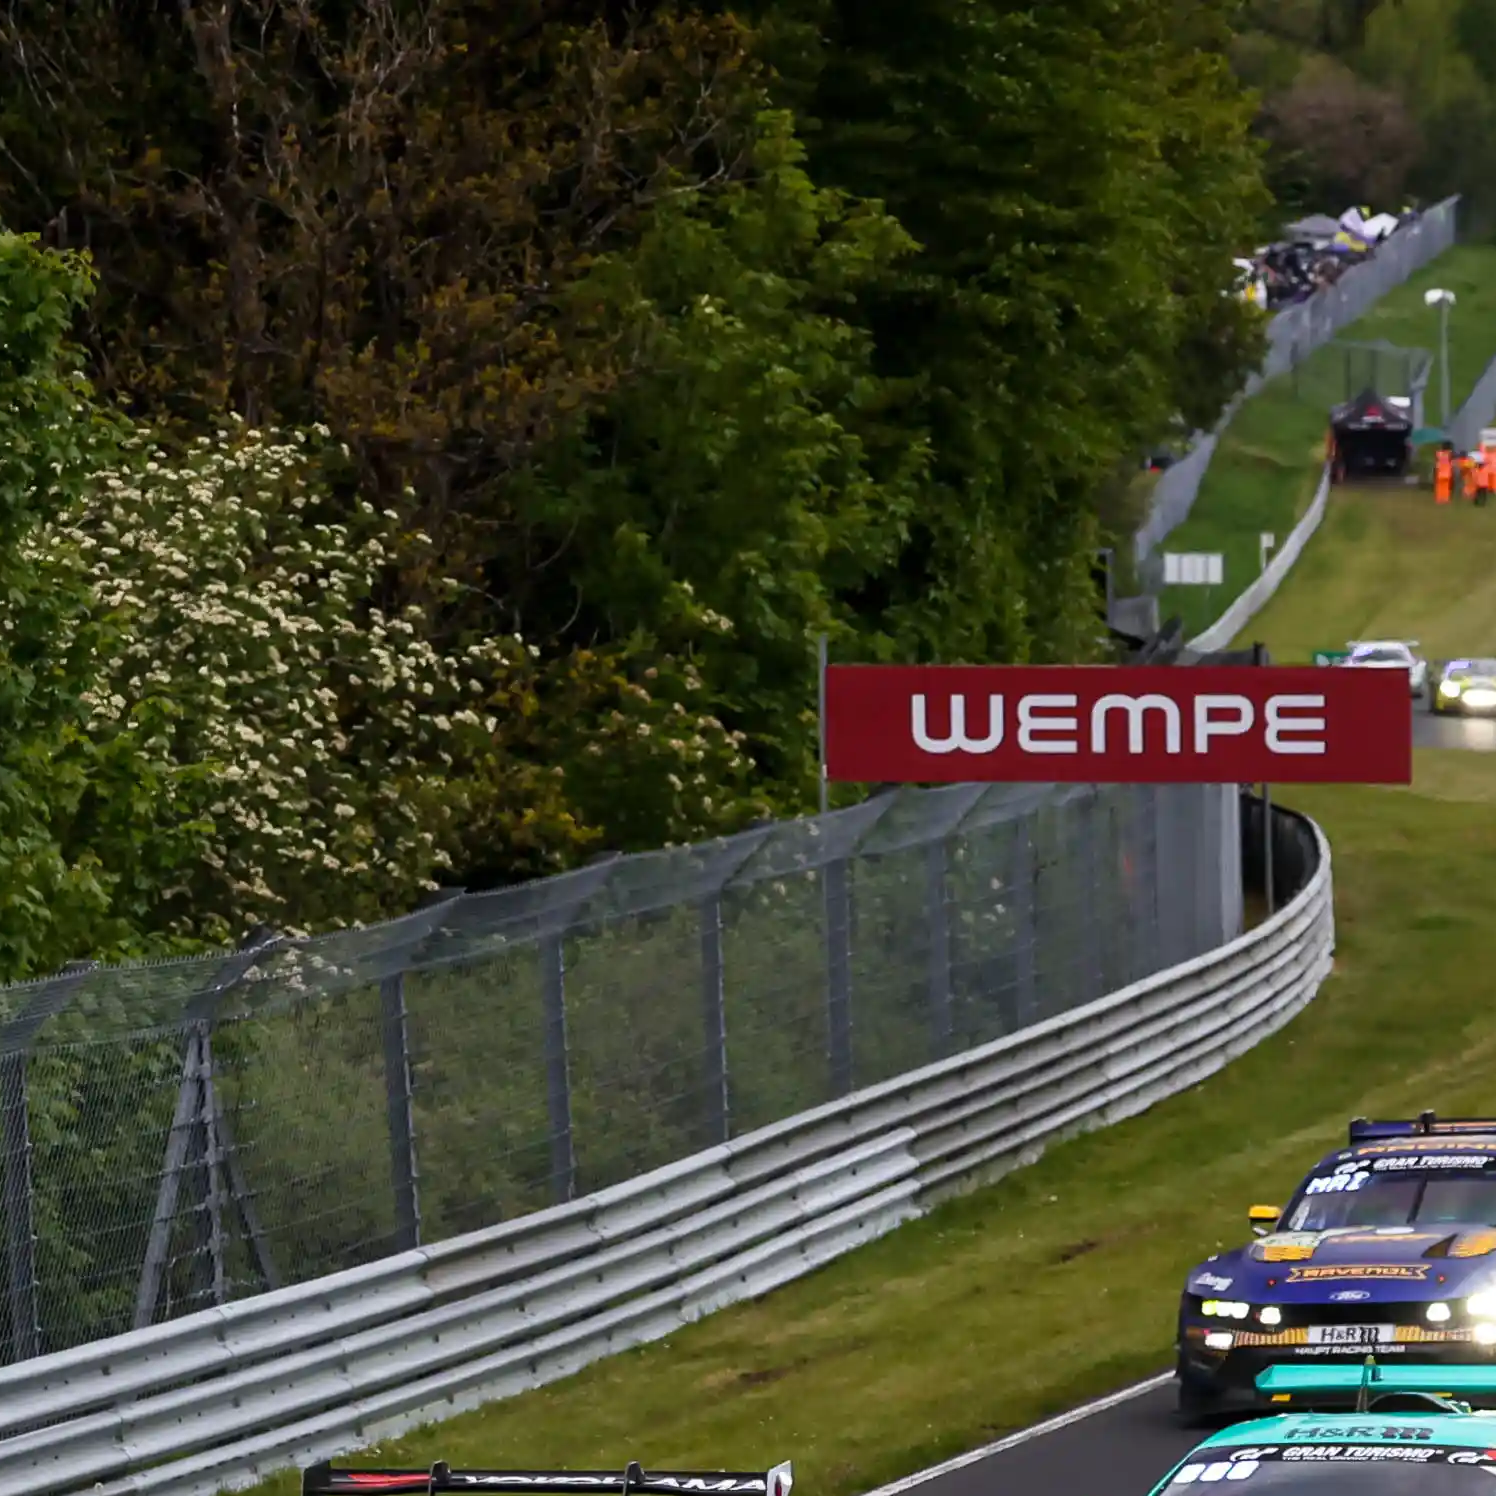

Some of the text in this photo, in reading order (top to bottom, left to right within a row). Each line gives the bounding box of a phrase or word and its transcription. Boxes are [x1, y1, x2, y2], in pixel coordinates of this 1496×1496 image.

[911, 693, 1326, 754] WEMPE
[1303, 1267, 1413, 1278] RAVENOL
[1321, 1327, 1357, 1343] H&R
[1295, 1344, 1406, 1355] HAUPT RACING TEAM
[1283, 1425, 1372, 1441] H&R
[1282, 1446, 1343, 1458] GRAN
[1344, 1446, 1438, 1459] TURISMO
